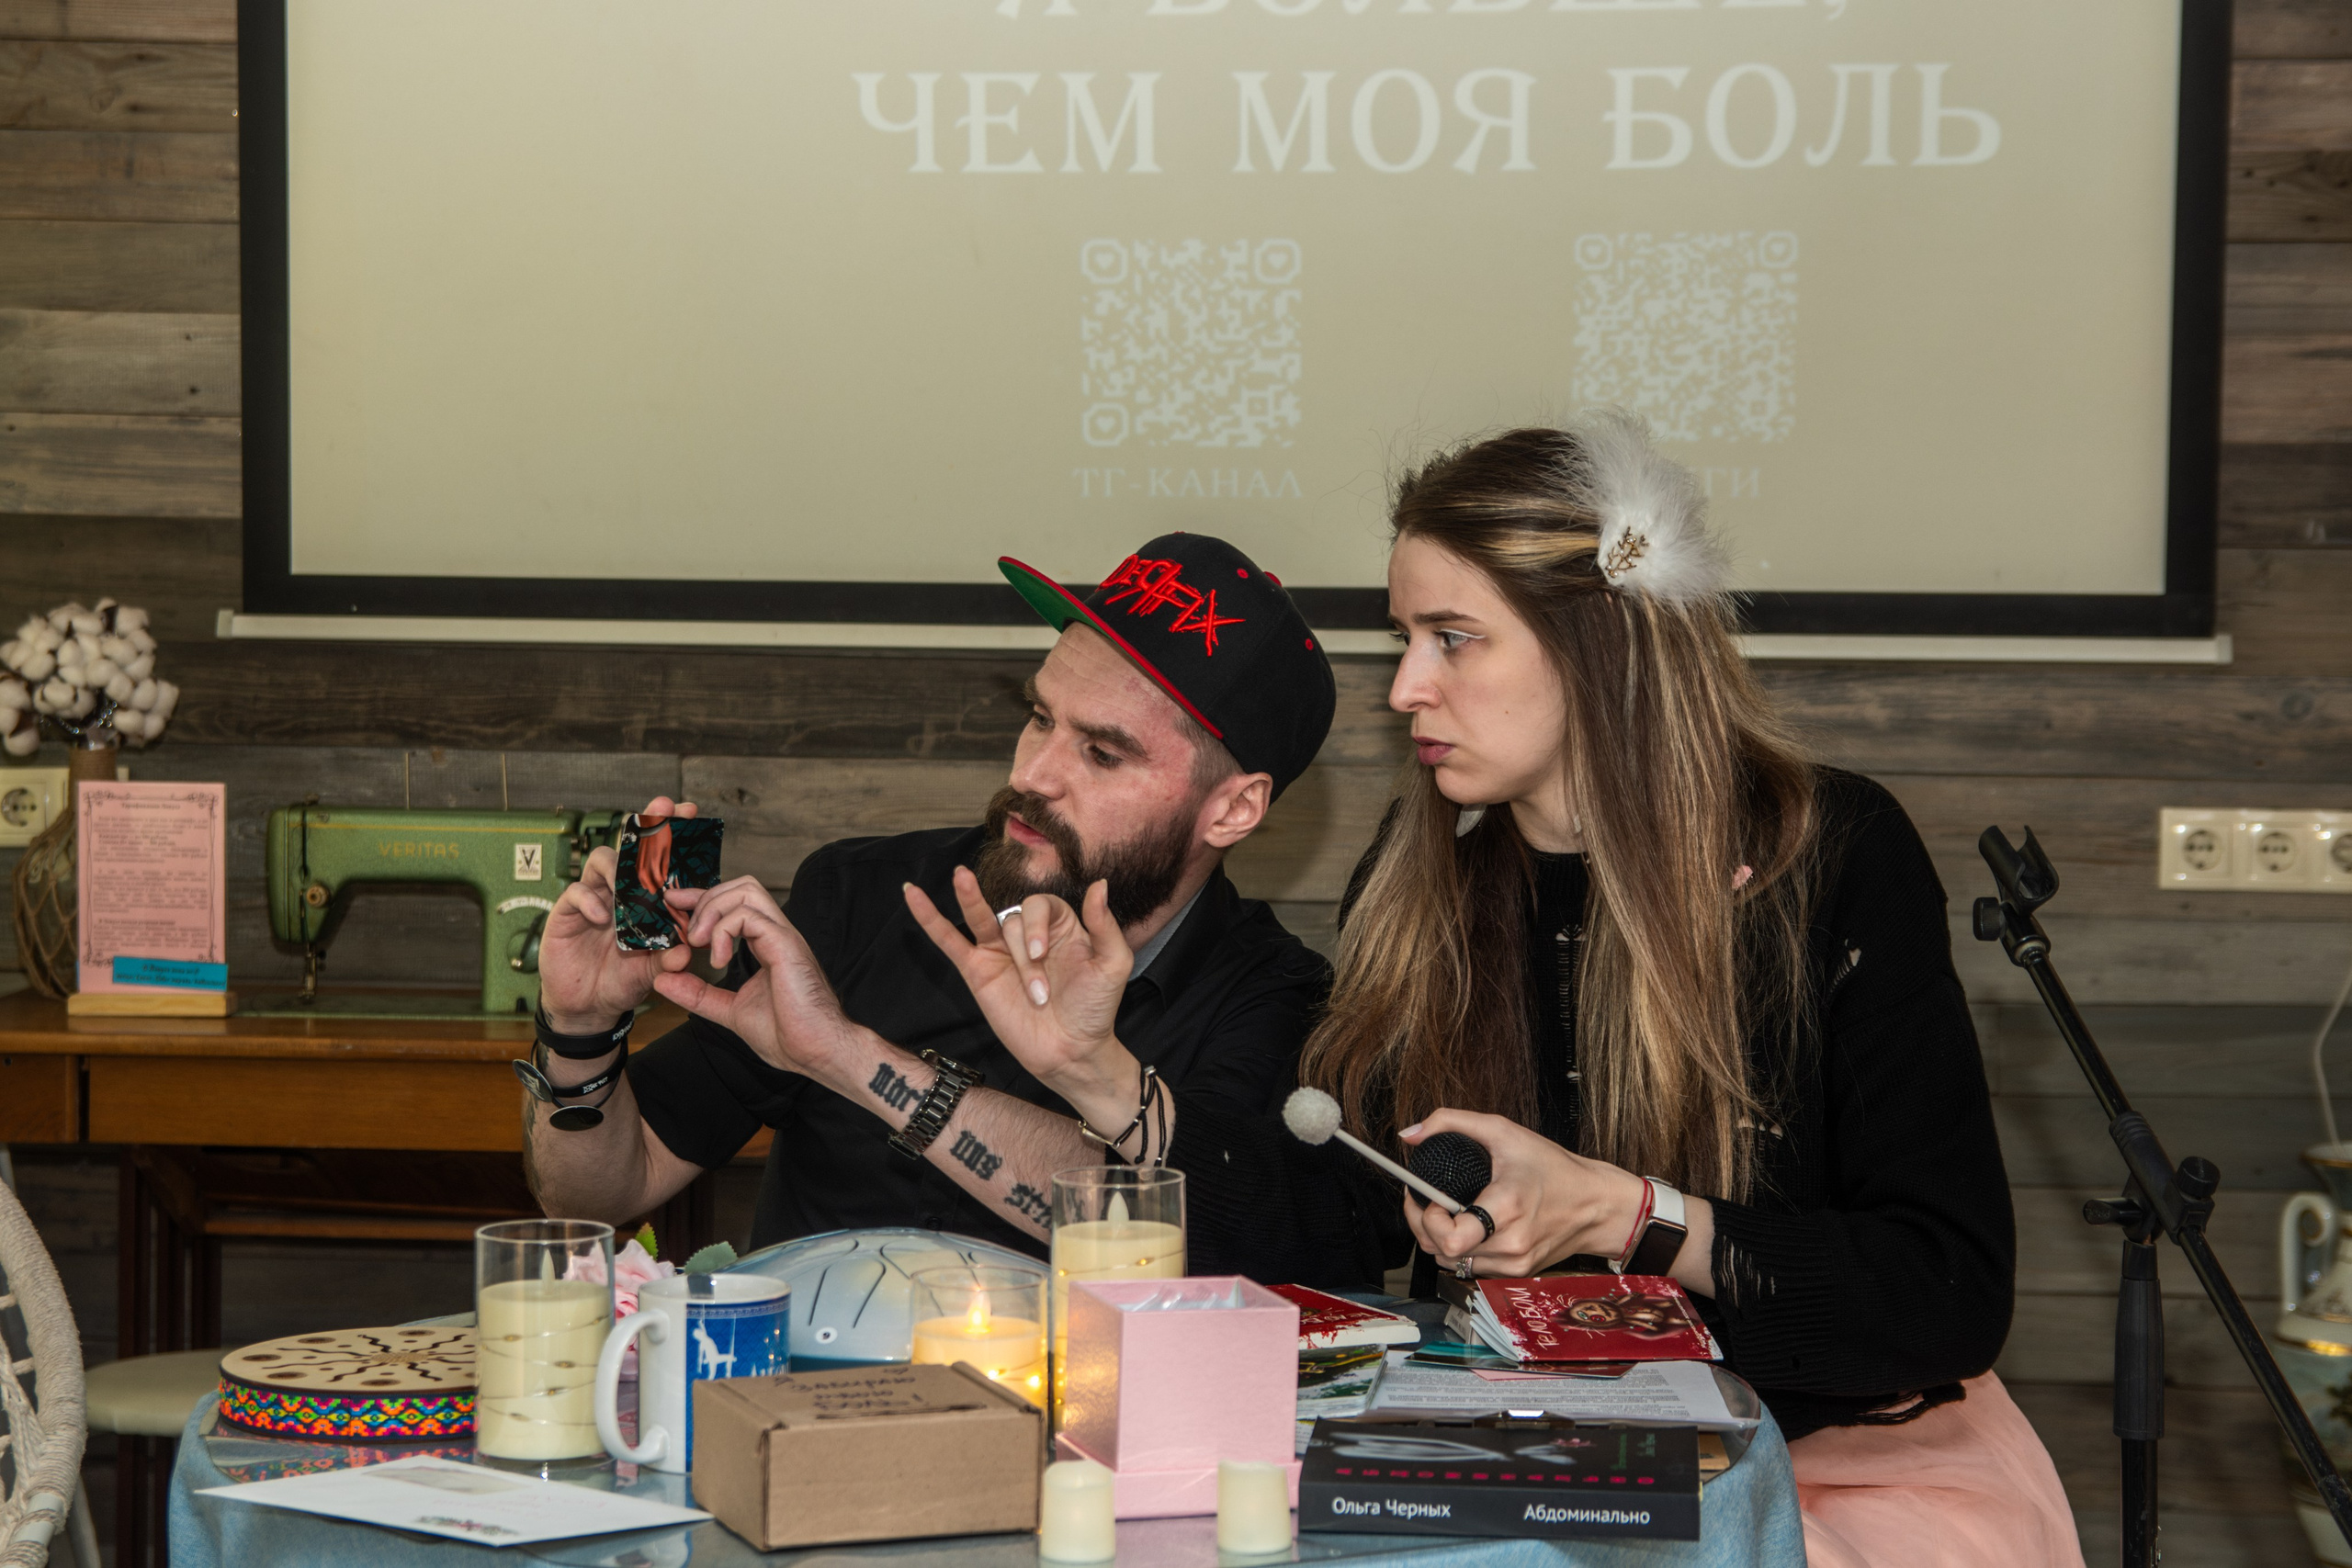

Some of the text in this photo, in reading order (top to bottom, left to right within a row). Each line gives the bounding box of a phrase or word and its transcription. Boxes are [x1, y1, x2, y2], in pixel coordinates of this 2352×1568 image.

[851, 62, 2003, 175] ЧЕМ МОЯ БОЛЬ
[1072, 467, 1302, 498] ТГ-КАНАЛ
[379, 841, 459, 859] VERITAS
[1332, 1496, 1650, 1525] Ольга Черных Абдоминально
